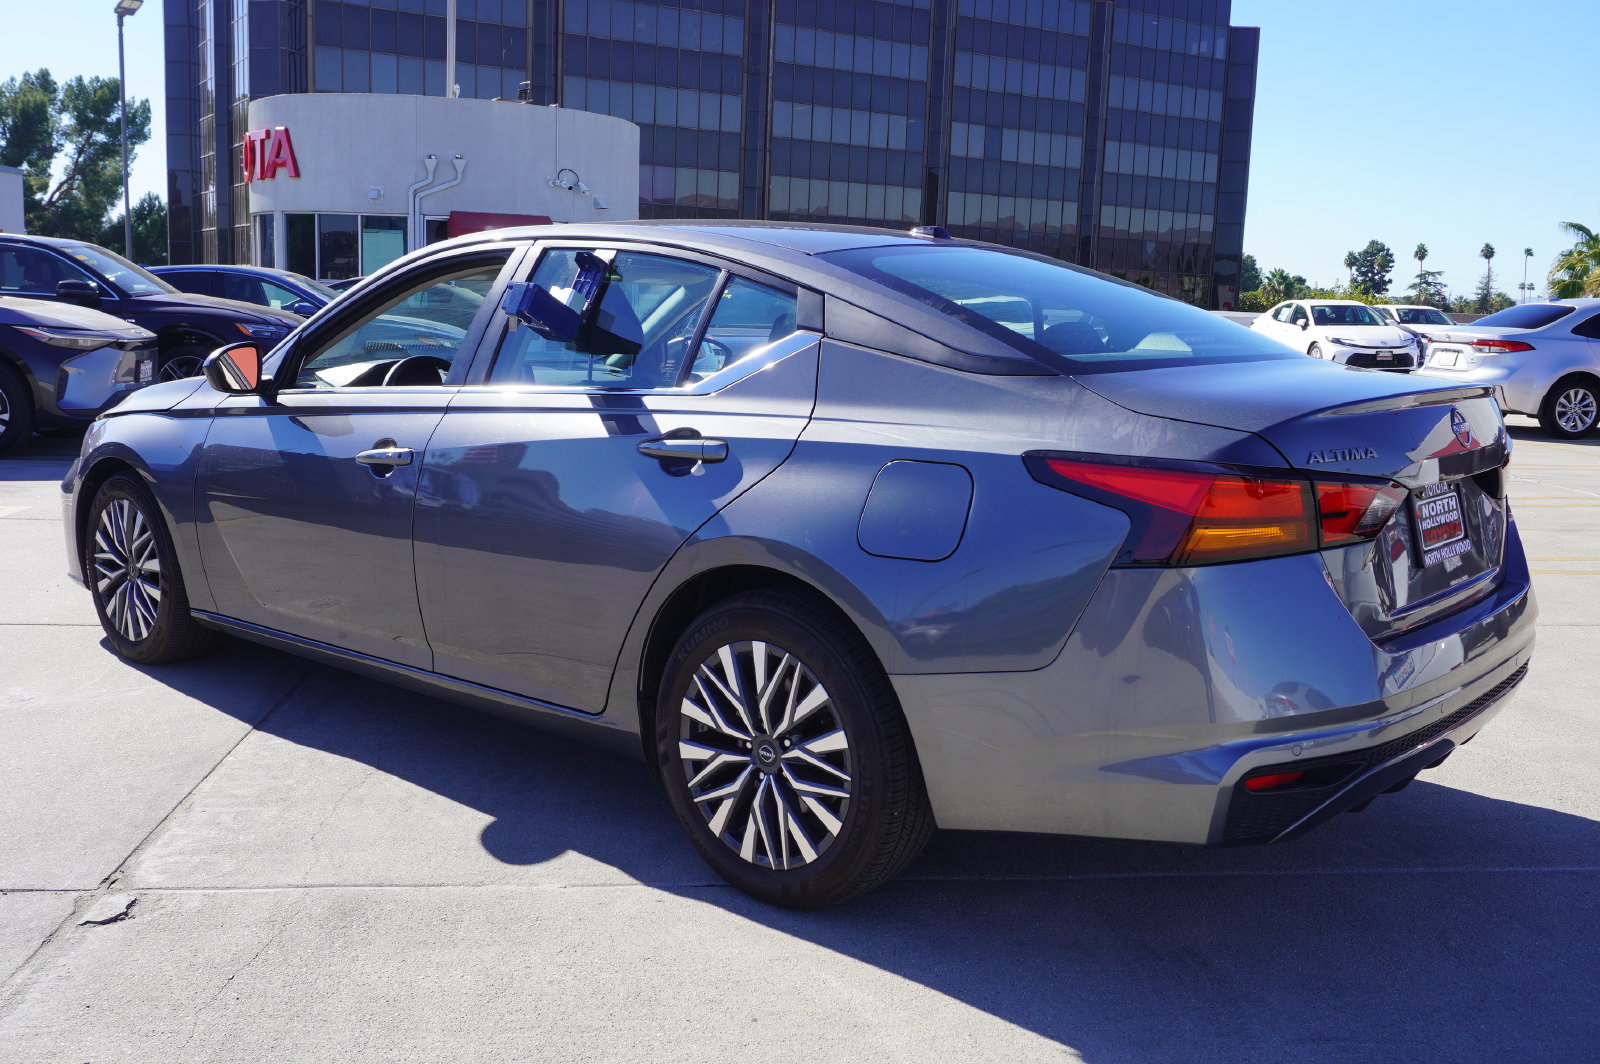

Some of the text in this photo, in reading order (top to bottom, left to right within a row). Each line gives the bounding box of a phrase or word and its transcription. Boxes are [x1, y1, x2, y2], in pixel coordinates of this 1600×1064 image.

[1307, 446, 1378, 464] ALTIMA
[1422, 496, 1456, 518] NORTH
[1422, 510, 1459, 530] HOLLYWOOD
[1423, 522, 1461, 545] TOYOTA
[1424, 549, 1441, 566] NORTH
[1441, 540, 1471, 559] HOLLYWOOD
[677, 615, 729, 662] KUMHO
